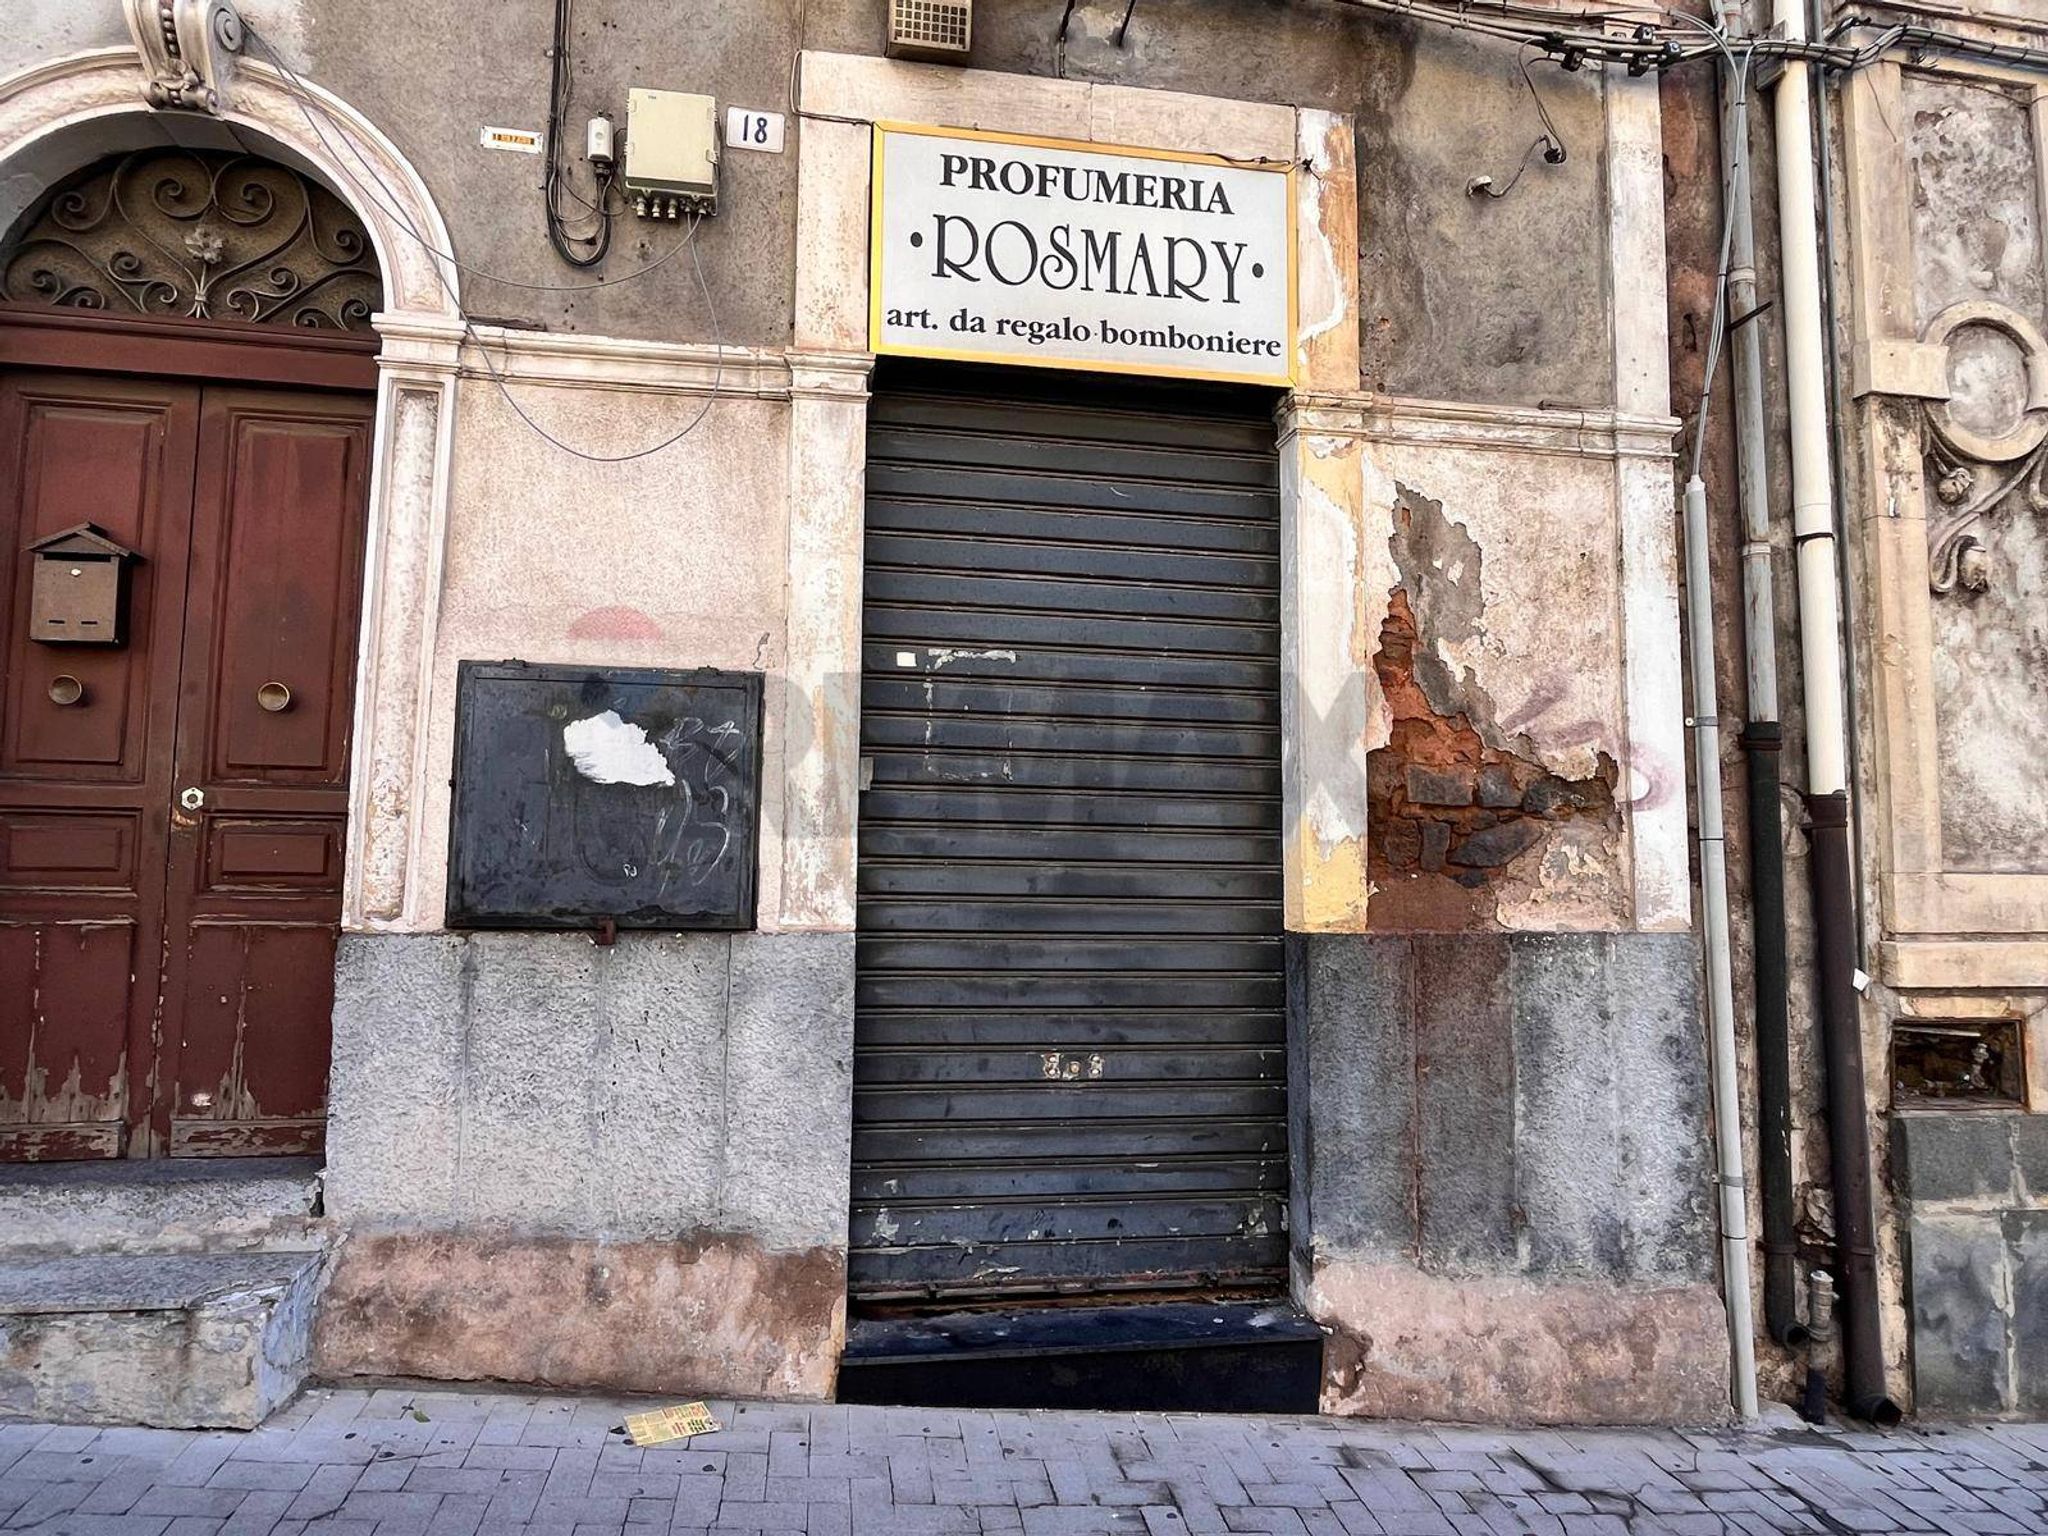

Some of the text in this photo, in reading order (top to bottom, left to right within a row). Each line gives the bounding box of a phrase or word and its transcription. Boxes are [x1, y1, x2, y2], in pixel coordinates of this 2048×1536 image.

[742, 114, 768, 144] 18
[939, 153, 1235, 215] PROFUMERIA
[886, 308, 938, 330] art.
[949, 308, 986, 334] da
[1099, 319, 1281, 357] bomboniere
